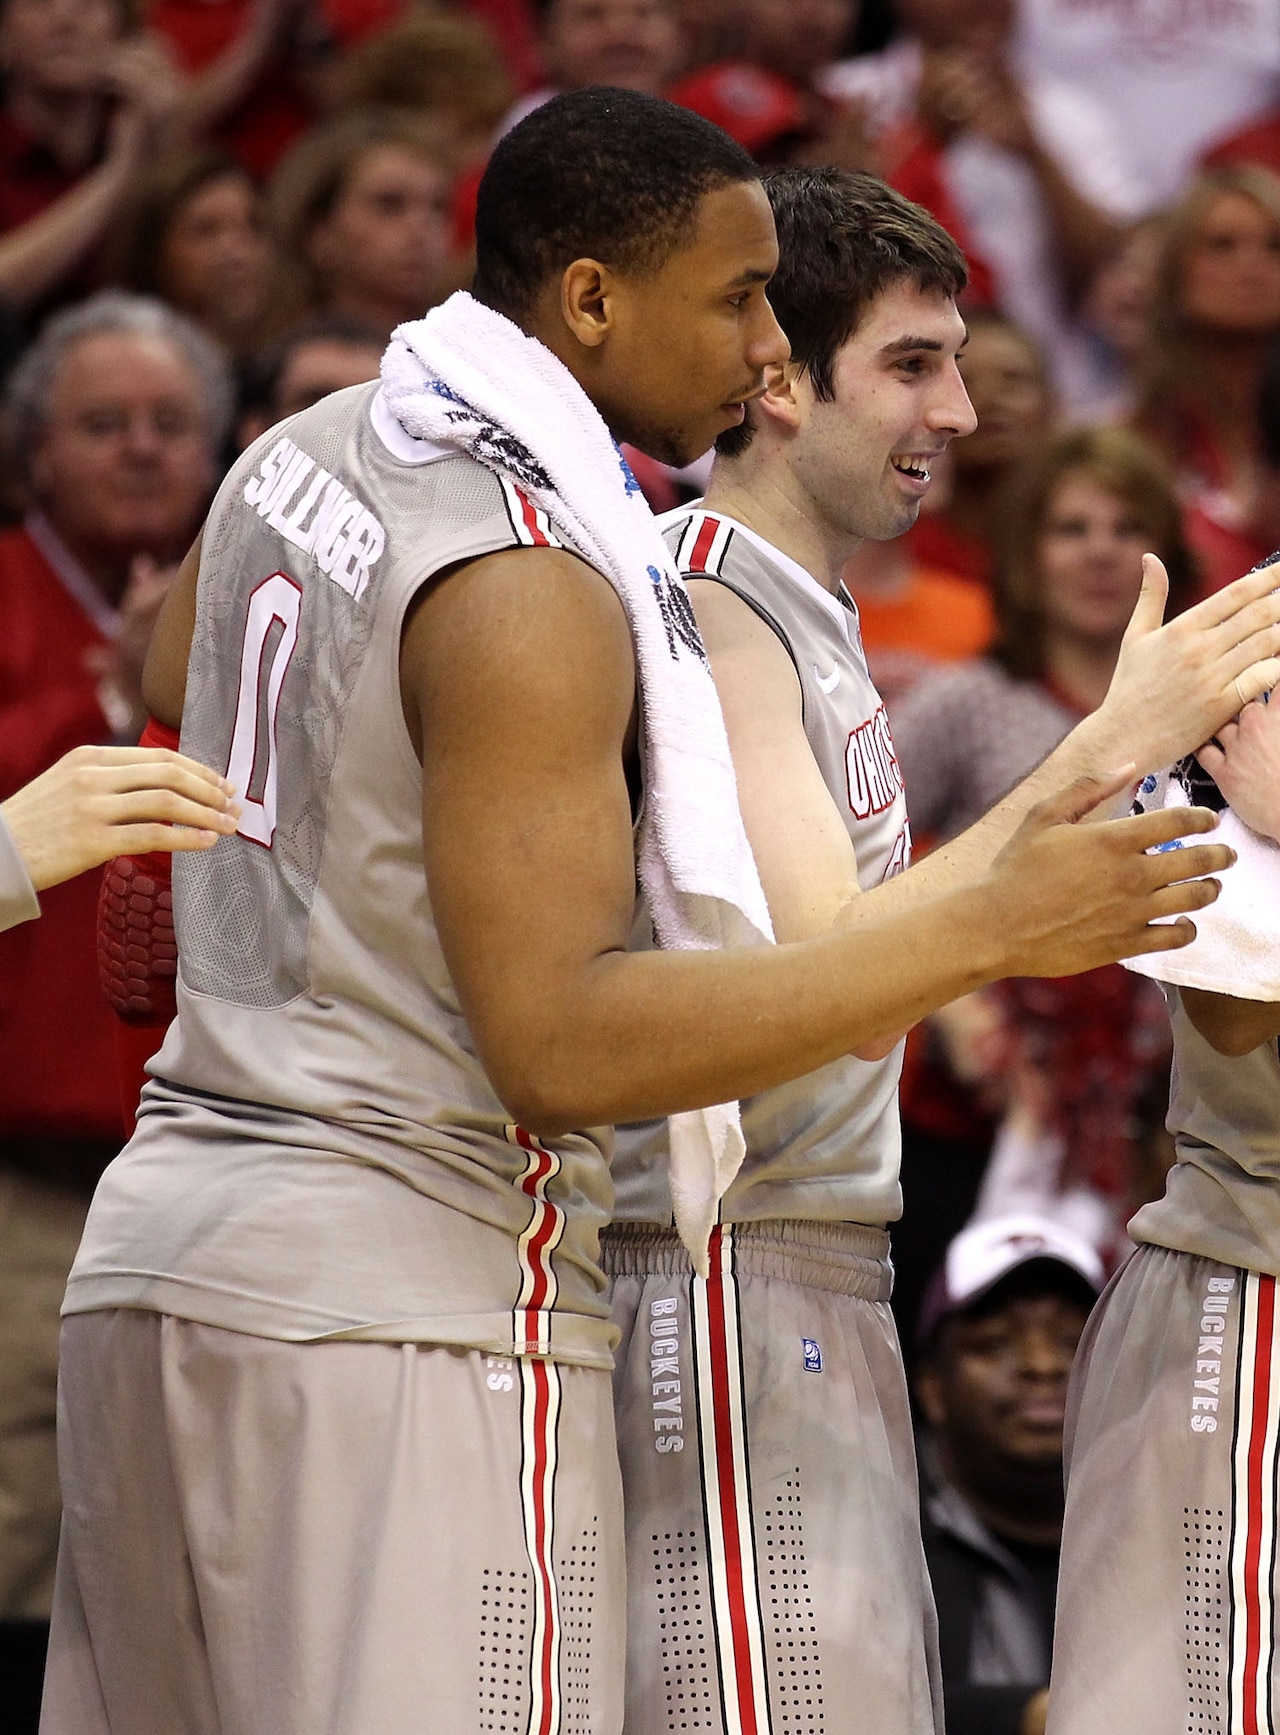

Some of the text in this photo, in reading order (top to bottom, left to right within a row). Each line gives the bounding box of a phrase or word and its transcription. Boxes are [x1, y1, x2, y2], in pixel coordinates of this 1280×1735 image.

[244, 437, 386, 603] SULLNGER
[226, 570, 303, 850] 0
[650, 1297, 685, 1454] BUCKEYES
[1190, 1277, 1236, 1434] BUCKEYES
